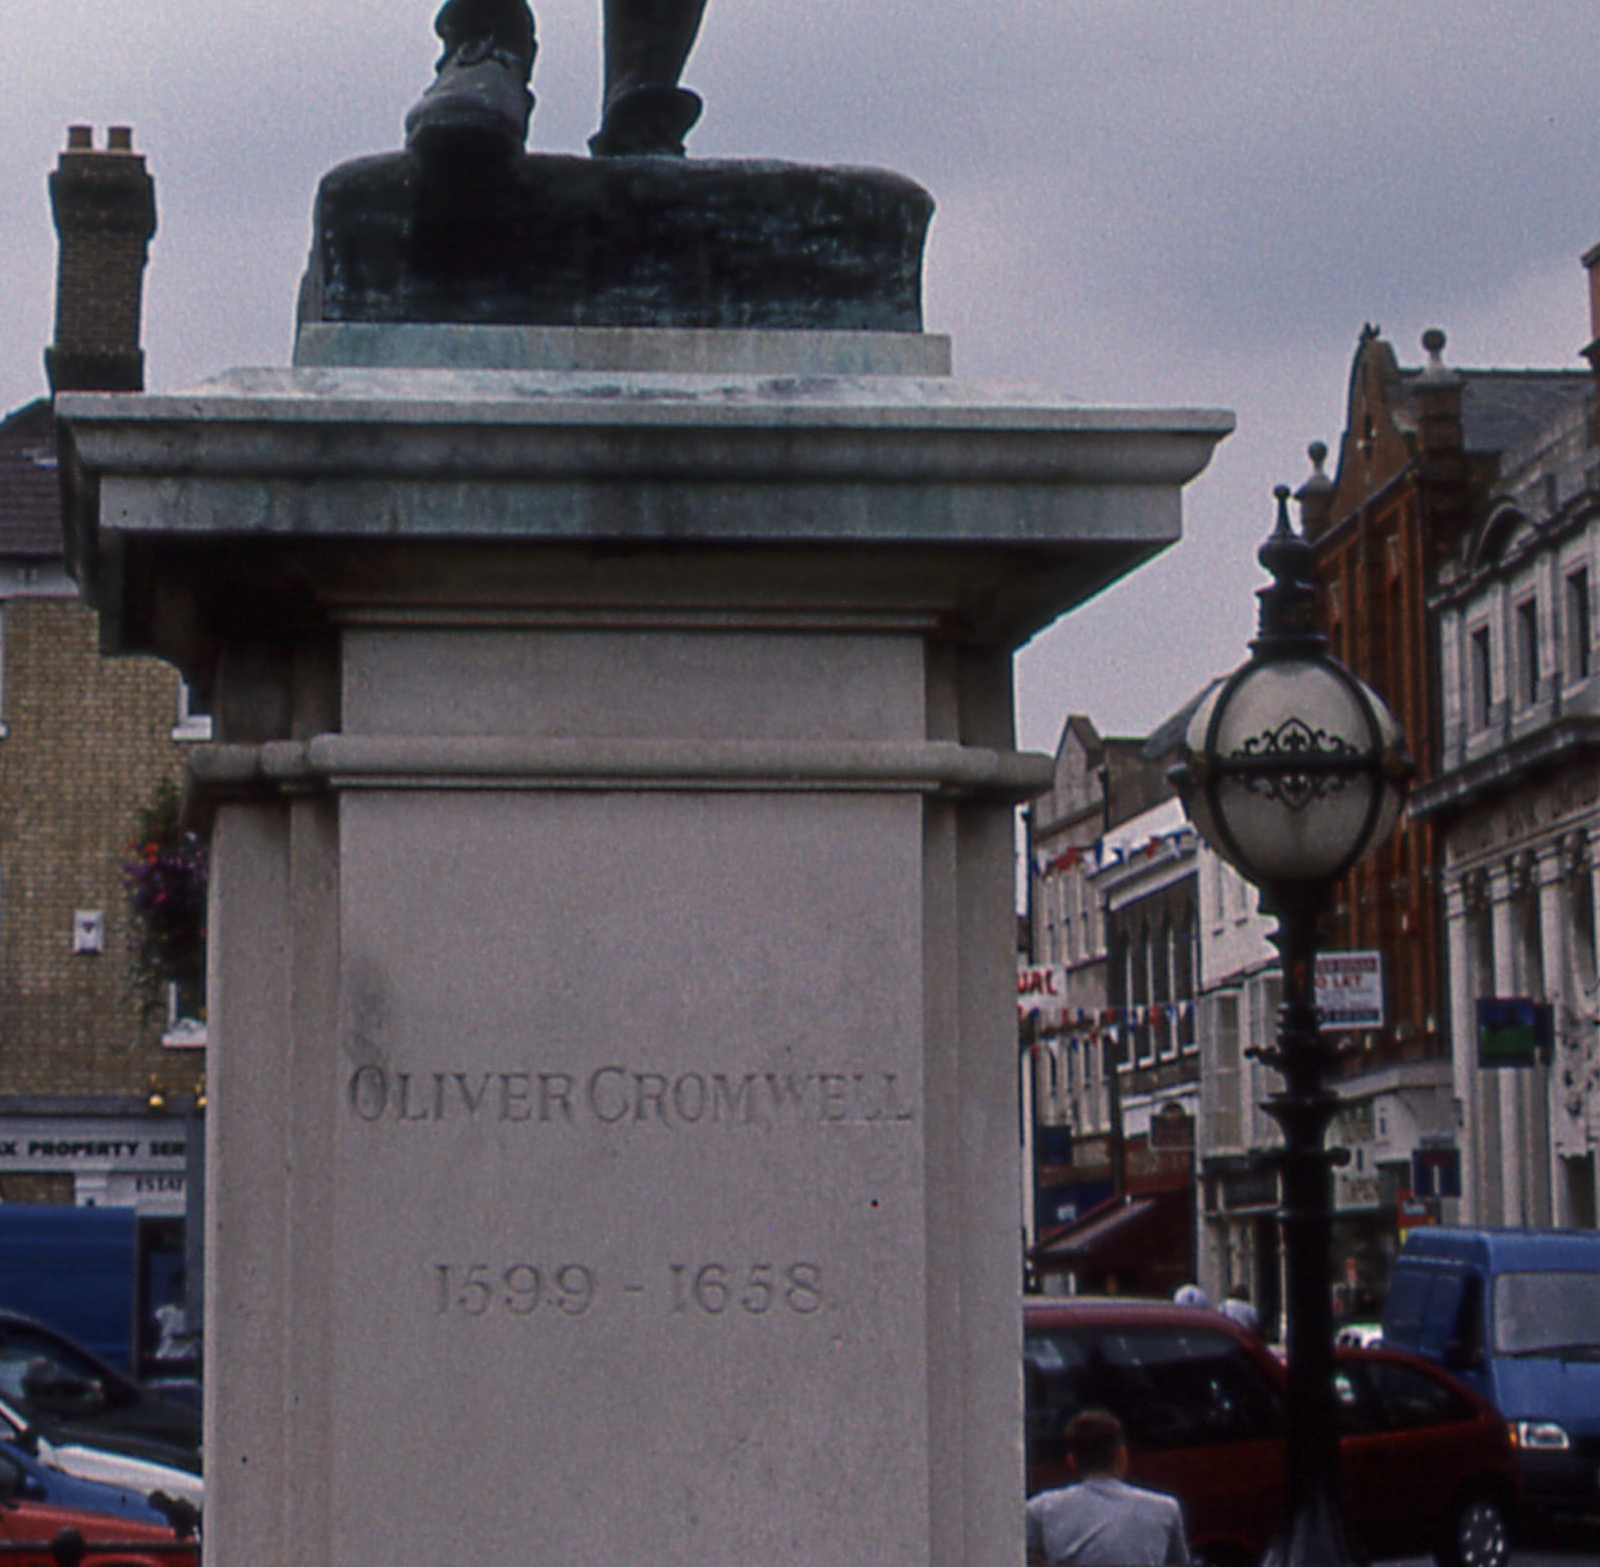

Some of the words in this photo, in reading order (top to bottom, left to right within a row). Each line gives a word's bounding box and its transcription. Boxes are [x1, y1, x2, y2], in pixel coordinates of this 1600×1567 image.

[349, 1064, 575, 1126] OLIVER
[589, 1066, 914, 1129] CROMWELL
[28, 1141, 140, 1156] PROPERTY
[433, 1264, 597, 1318] 1599
[667, 1262, 823, 1316] 1658
